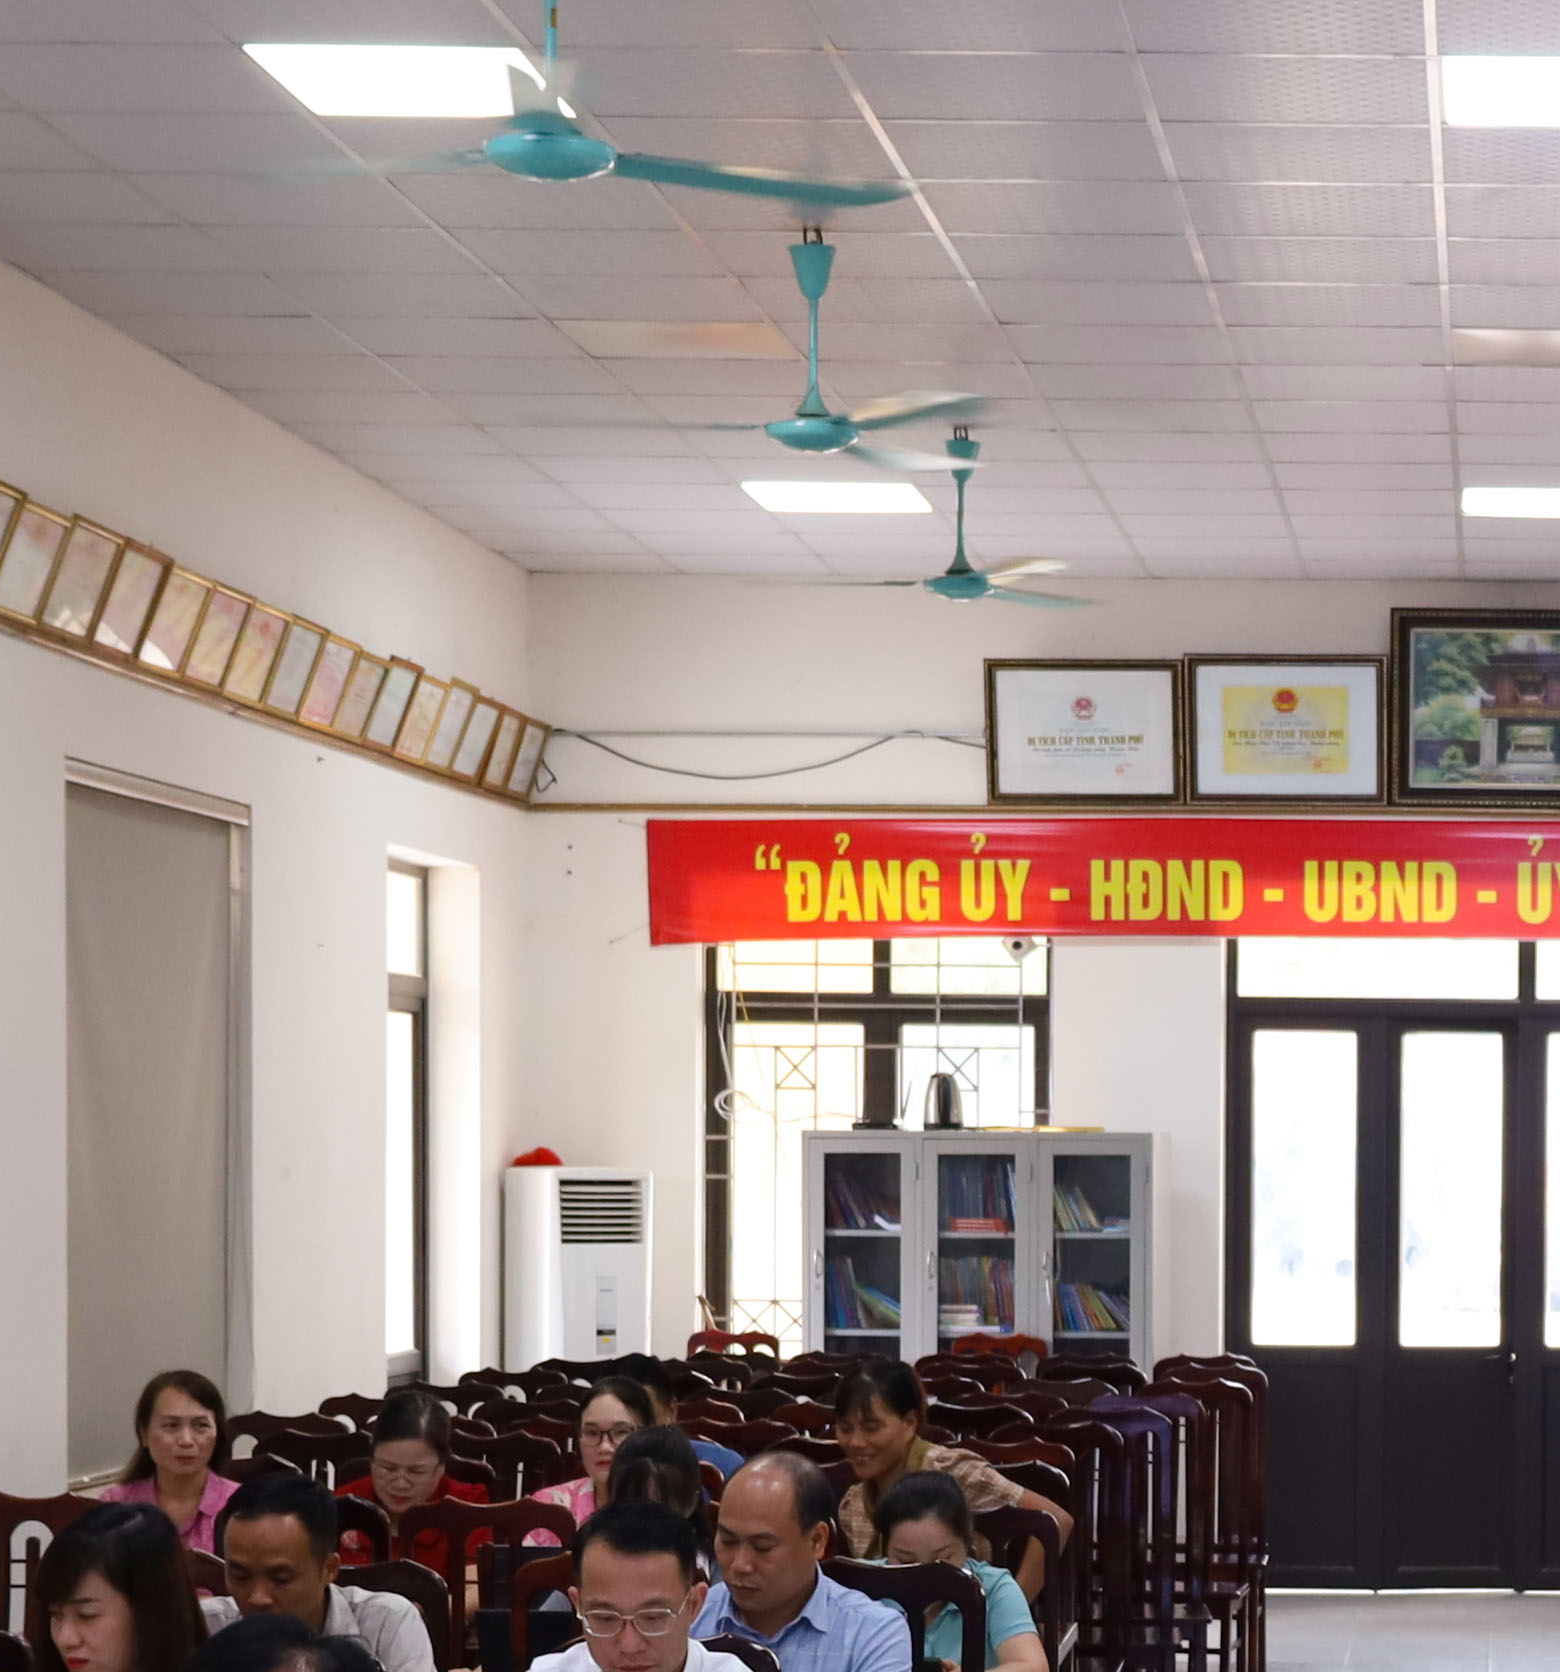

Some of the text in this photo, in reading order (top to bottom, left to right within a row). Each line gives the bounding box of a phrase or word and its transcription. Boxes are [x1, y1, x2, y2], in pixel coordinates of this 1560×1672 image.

[754, 831, 942, 923] “ĐẢNG
[960, 831, 1032, 922] ỦY
[1049, 887, 1071, 902] -
[1090, 859, 1244, 922] HĐND
[1263, 887, 1285, 902] -
[1303, 859, 1459, 923] UBND
[1477, 888, 1498, 903] -
